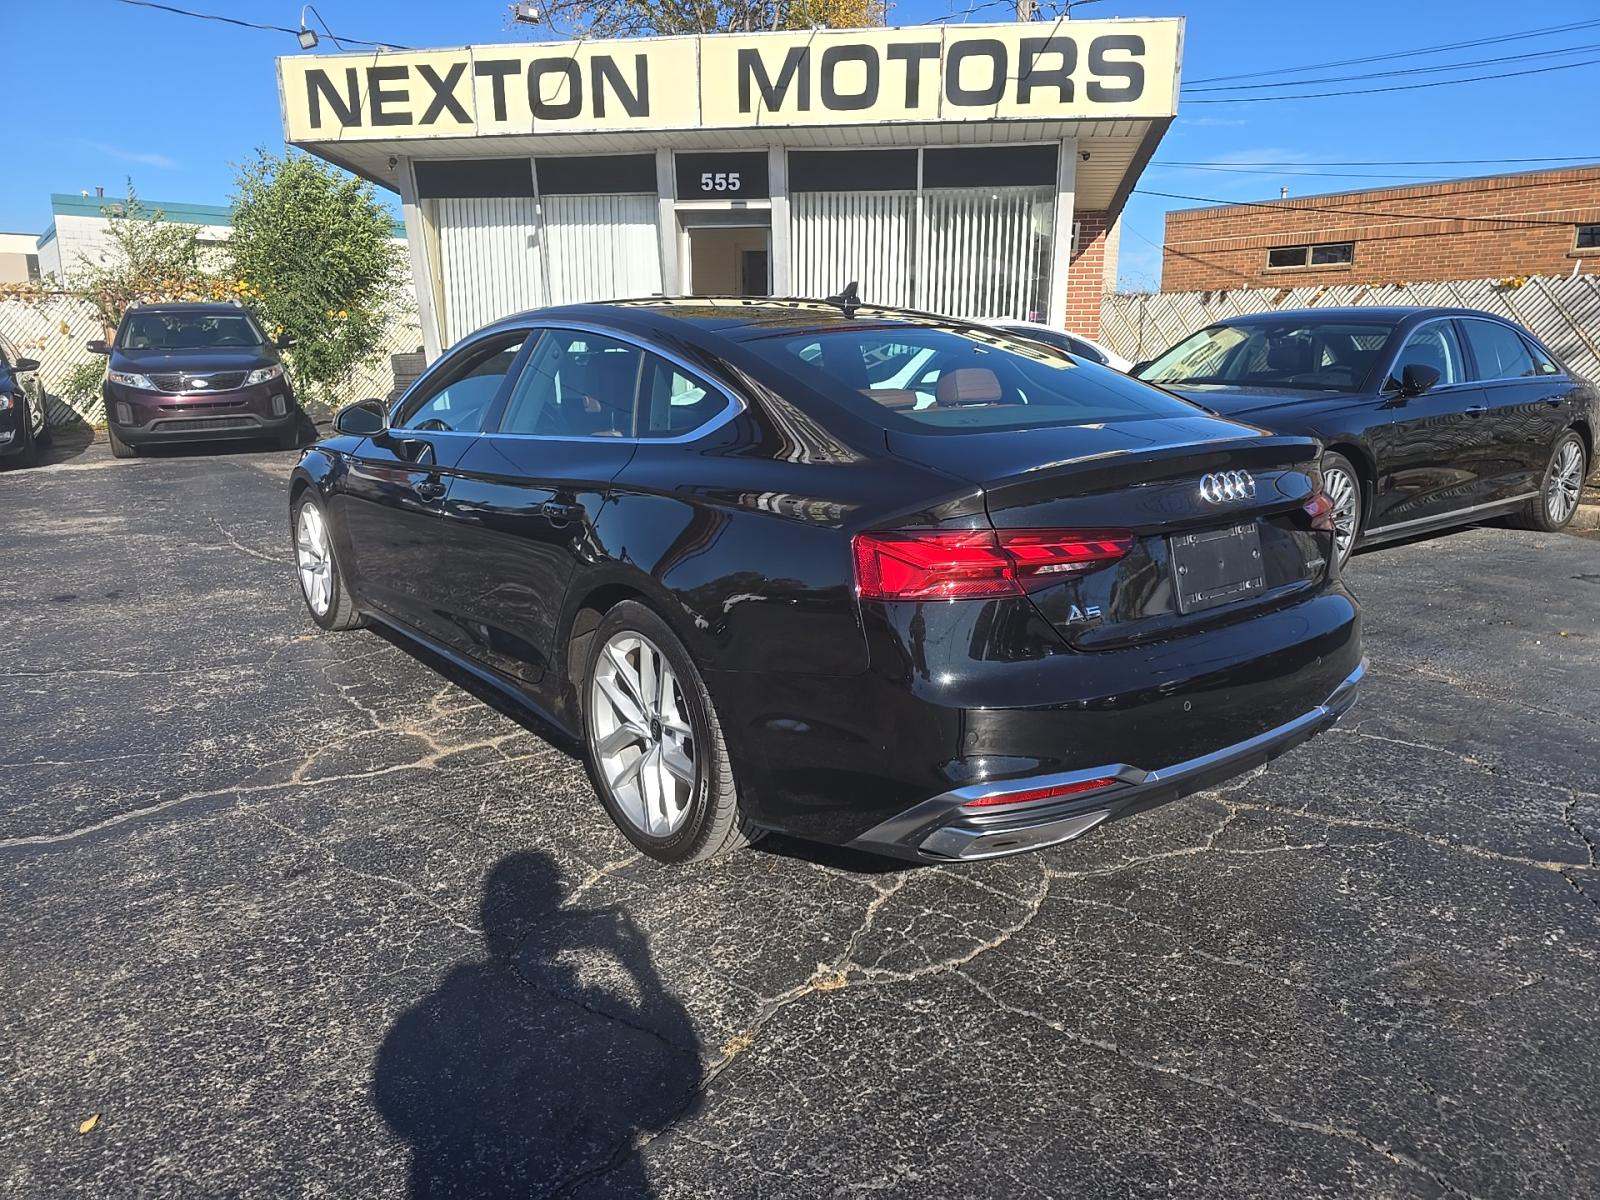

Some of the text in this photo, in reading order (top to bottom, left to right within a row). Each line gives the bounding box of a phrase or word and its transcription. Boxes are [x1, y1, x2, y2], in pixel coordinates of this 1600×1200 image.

[305, 35, 1146, 129] NEXTON MOTORS
[701, 173, 741, 191] 555
[1065, 605, 1101, 625] A5
